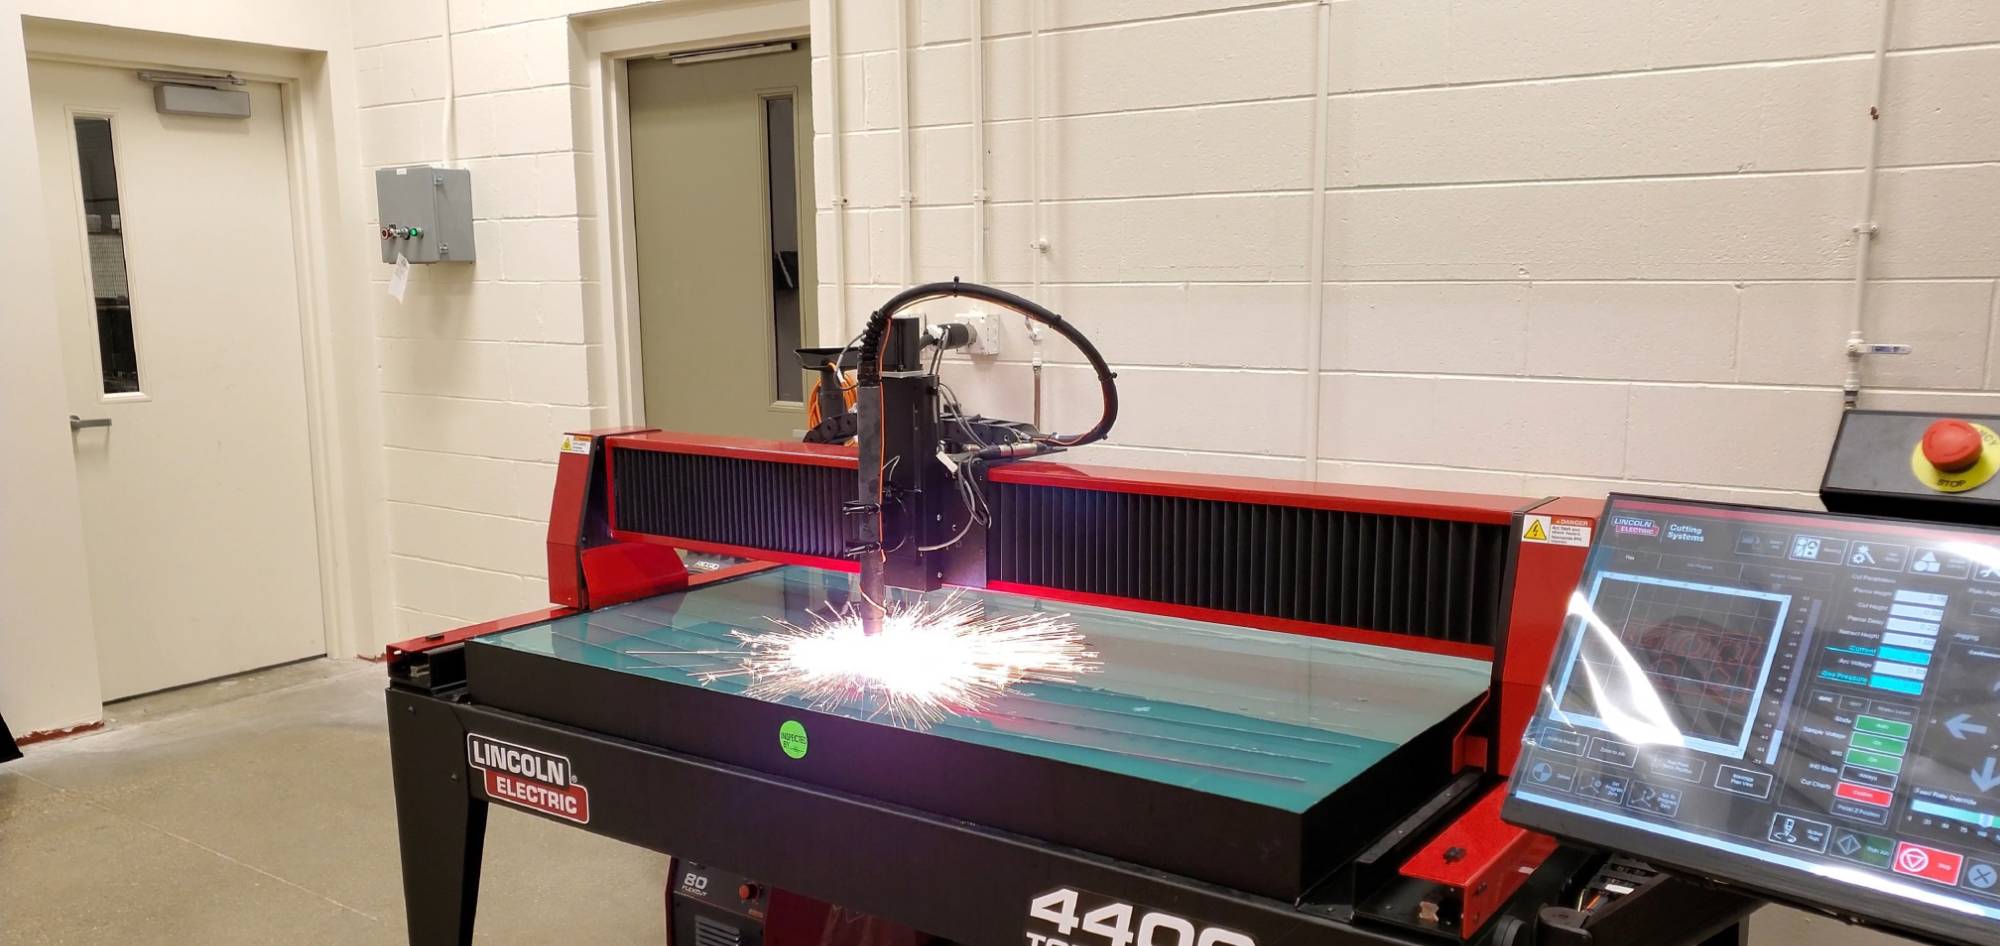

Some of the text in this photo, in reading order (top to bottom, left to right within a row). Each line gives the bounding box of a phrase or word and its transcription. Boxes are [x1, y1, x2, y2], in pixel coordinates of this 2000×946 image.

[1937, 479, 1966, 488] STOP
[1614, 518, 1652, 528] LINCOLN
[1670, 523, 1702, 535] Cutting
[1620, 526, 1655, 535] ELECTRIC
[1667, 532, 1705, 543] Systems
[781, 732, 807, 745] INSPECTED
[473, 741, 565, 787] LINCOLN
[496, 776, 578, 815] ELECTRIC
[684, 872, 708, 890] 80
